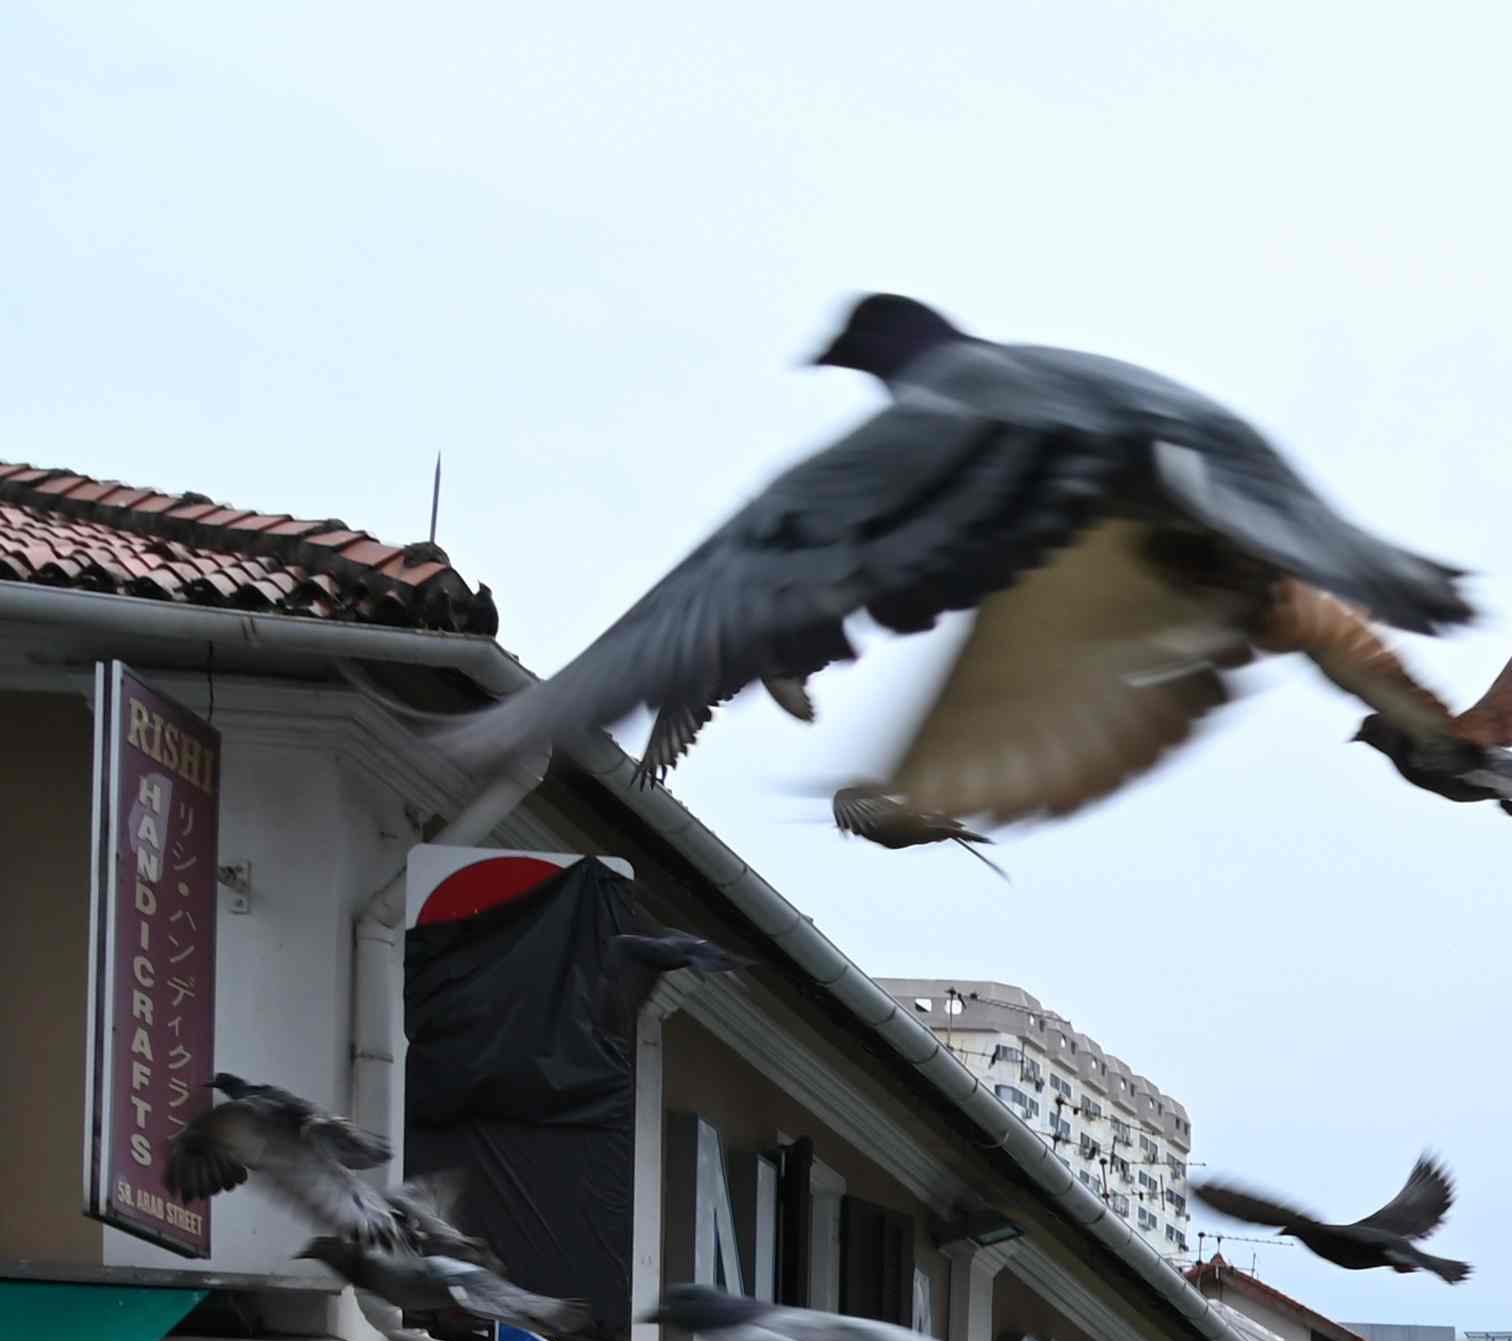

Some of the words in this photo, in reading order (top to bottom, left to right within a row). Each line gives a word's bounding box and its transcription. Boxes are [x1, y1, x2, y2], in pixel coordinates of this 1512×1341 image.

[127, 697, 213, 796] RISHI
[130, 775, 161, 1167] HANDICRAFTS
[136, 1189, 165, 1221] ARAB
[166, 1201, 204, 1236] STREET
